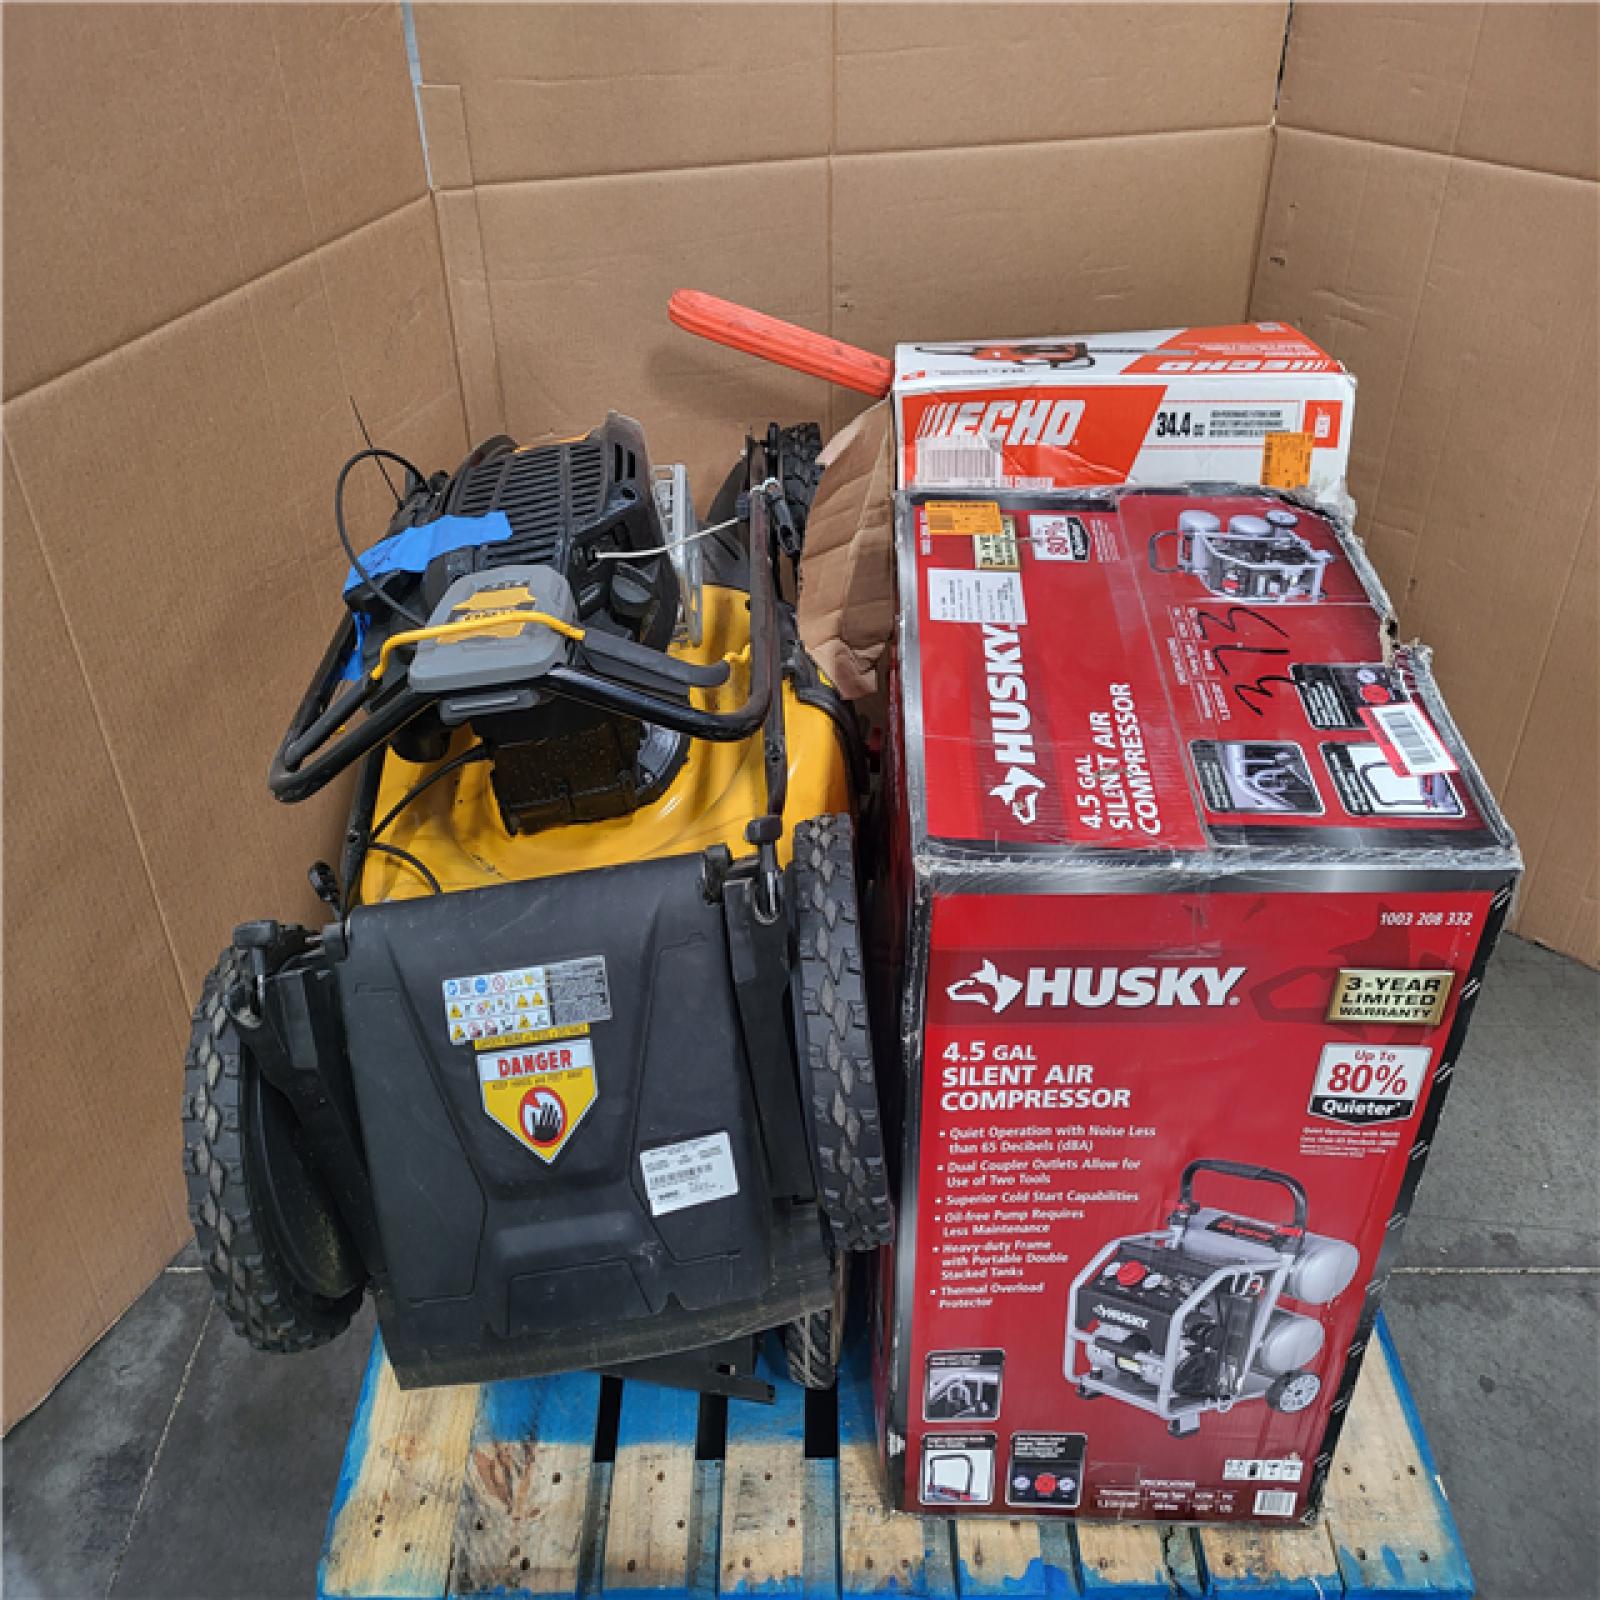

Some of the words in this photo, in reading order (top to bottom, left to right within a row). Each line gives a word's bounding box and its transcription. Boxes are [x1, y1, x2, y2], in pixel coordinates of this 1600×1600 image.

[951, 399, 1086, 446] ECHO
[1157, 412, 1191, 438] 34.4
[982, 623, 1037, 766] HUSKY
[1089, 711, 1116, 749] AIR
[1110, 682, 1161, 836] COMPRESSOR
[1075, 754, 1096, 789] GAL
[1097, 753, 1133, 831] SILENT
[1076, 794, 1103, 829] 4.5
[1379, 912, 1413, 926] 1003
[1445, 912, 1473, 926] 332
[1025, 967, 1247, 1008] HUSKY
[1345, 977, 1441, 992] 3-YEAR
[1342, 994, 1437, 1006] LIMITED
[1339, 1007, 1433, 1018] WARRANTY
[942, 1041, 986, 1062] 4.5
[992, 1045, 1037, 1061] GAL
[1354, 1050, 1375, 1061] Up
[1379, 1051, 1396, 1061] To
[498, 1049, 572, 1077] DANGER
[942, 1065, 1038, 1087] SILENT
[1044, 1064, 1094, 1085] AIR
[1328, 1062, 1408, 1095] 80%
[941, 1089, 1131, 1111] COMPRESSOR
[950, 1127, 985, 1140] Quiet
[988, 1125, 1052, 1138] Operation
[1056, 1124, 1085, 1136] with
[1089, 1125, 1125, 1136] Noise
[1129, 1126, 1156, 1136] Less
[949, 1142, 978, 1154] than
[981, 1142, 996, 1153] 65
[1001, 1140, 1053, 1152] Decibels
[1057, 1139, 1094, 1152] (dBA)
[947, 1160, 976, 1173] Dual
[980, 1159, 1028, 1173] Coupler
[1032, 1158, 1078, 1170] Outlets
[1082, 1157, 1119, 1169] Allow
[1122, 1158, 1141, 1169] for
[947, 1176, 969, 1187] Use
[972, 1175, 986, 1186] of
[990, 1175, 1015, 1186] Two
[1019, 1173, 1050, 1185] Tools
[946, 1194, 997, 1206] Superior
[1001, 1191, 1029, 1203] Cold
[1032, 1190, 1063, 1202] Start
[1066, 1189, 1139, 1203] Capabilities
[944, 1210, 990, 1223] Oil-free
[993, 1210, 1028, 1222] Pump
[1032, 1208, 1084, 1220] Requires
[943, 1226, 968, 1237] Less
[972, 1223, 1050, 1236] Maintenance
[942, 1241, 1011, 1254] Heavy-duty
[1014, 1239, 1051, 1250] Frame
[941, 1256, 968, 1267] with
[972, 1254, 1022, 1266] Portable
[1025, 1252, 1069, 1264] Double
[941, 1268, 988, 1281] Stacked
[991, 1267, 1023, 1277] Tanks
[940, 1283, 988, 1295] Thermal
[991, 1282, 1045, 1293] Overload
[939, 1297, 993, 1309] Protector
